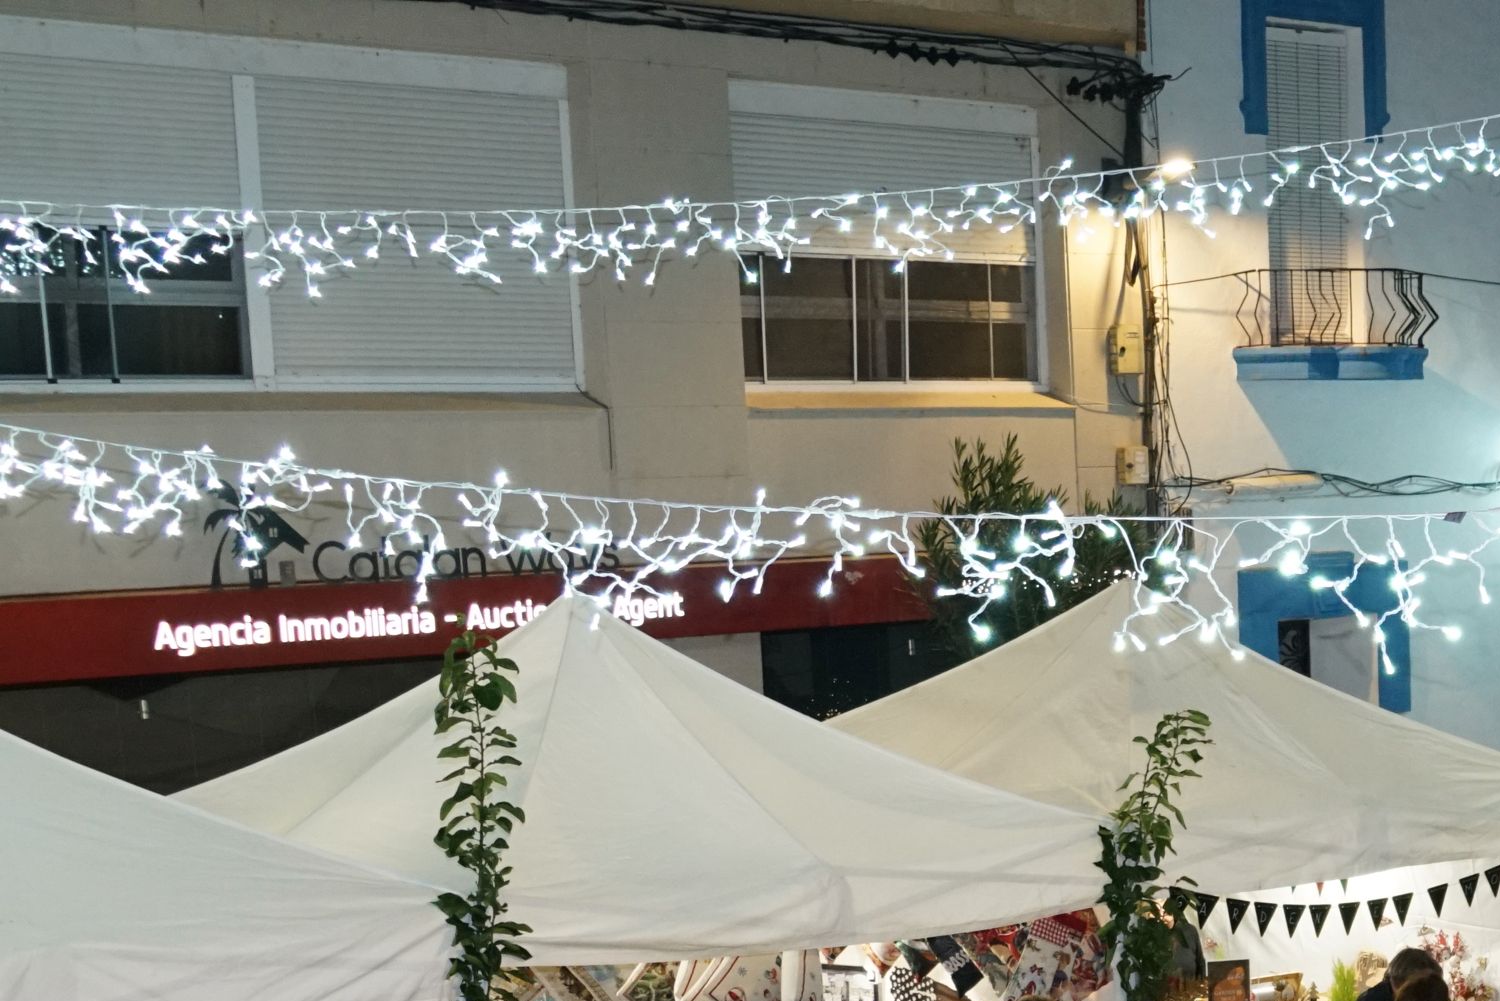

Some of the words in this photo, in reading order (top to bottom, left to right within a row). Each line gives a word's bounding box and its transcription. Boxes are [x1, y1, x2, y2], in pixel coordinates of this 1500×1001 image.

[154, 614, 271, 657] Agencia
[279, 605, 436, 643] Inmobiliaria
[613, 591, 685, 627] Agent
